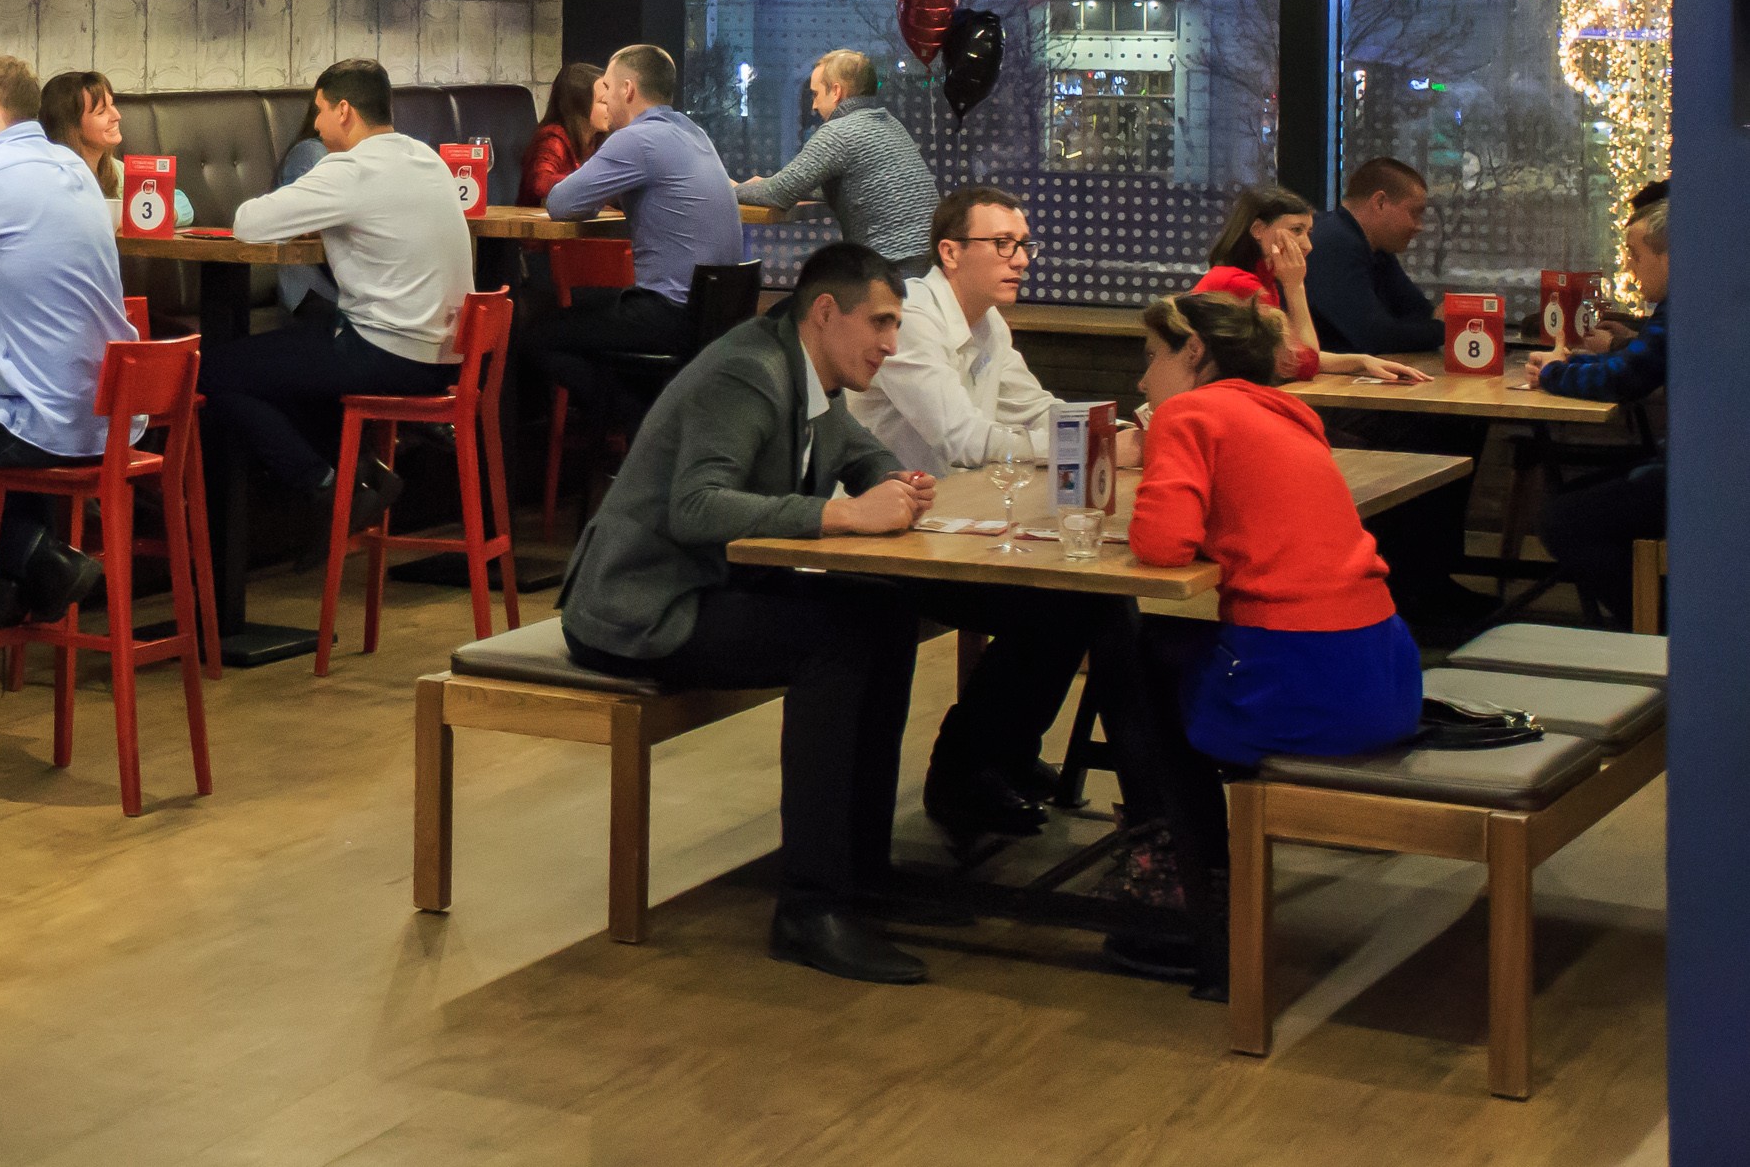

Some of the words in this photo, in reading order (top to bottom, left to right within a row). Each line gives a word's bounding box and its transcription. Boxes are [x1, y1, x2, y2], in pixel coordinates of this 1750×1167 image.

[458, 185, 468, 201] 2
[141, 201, 153, 220] 3
[1550, 311, 1558, 327] 9
[1468, 340, 1480, 358] 8
